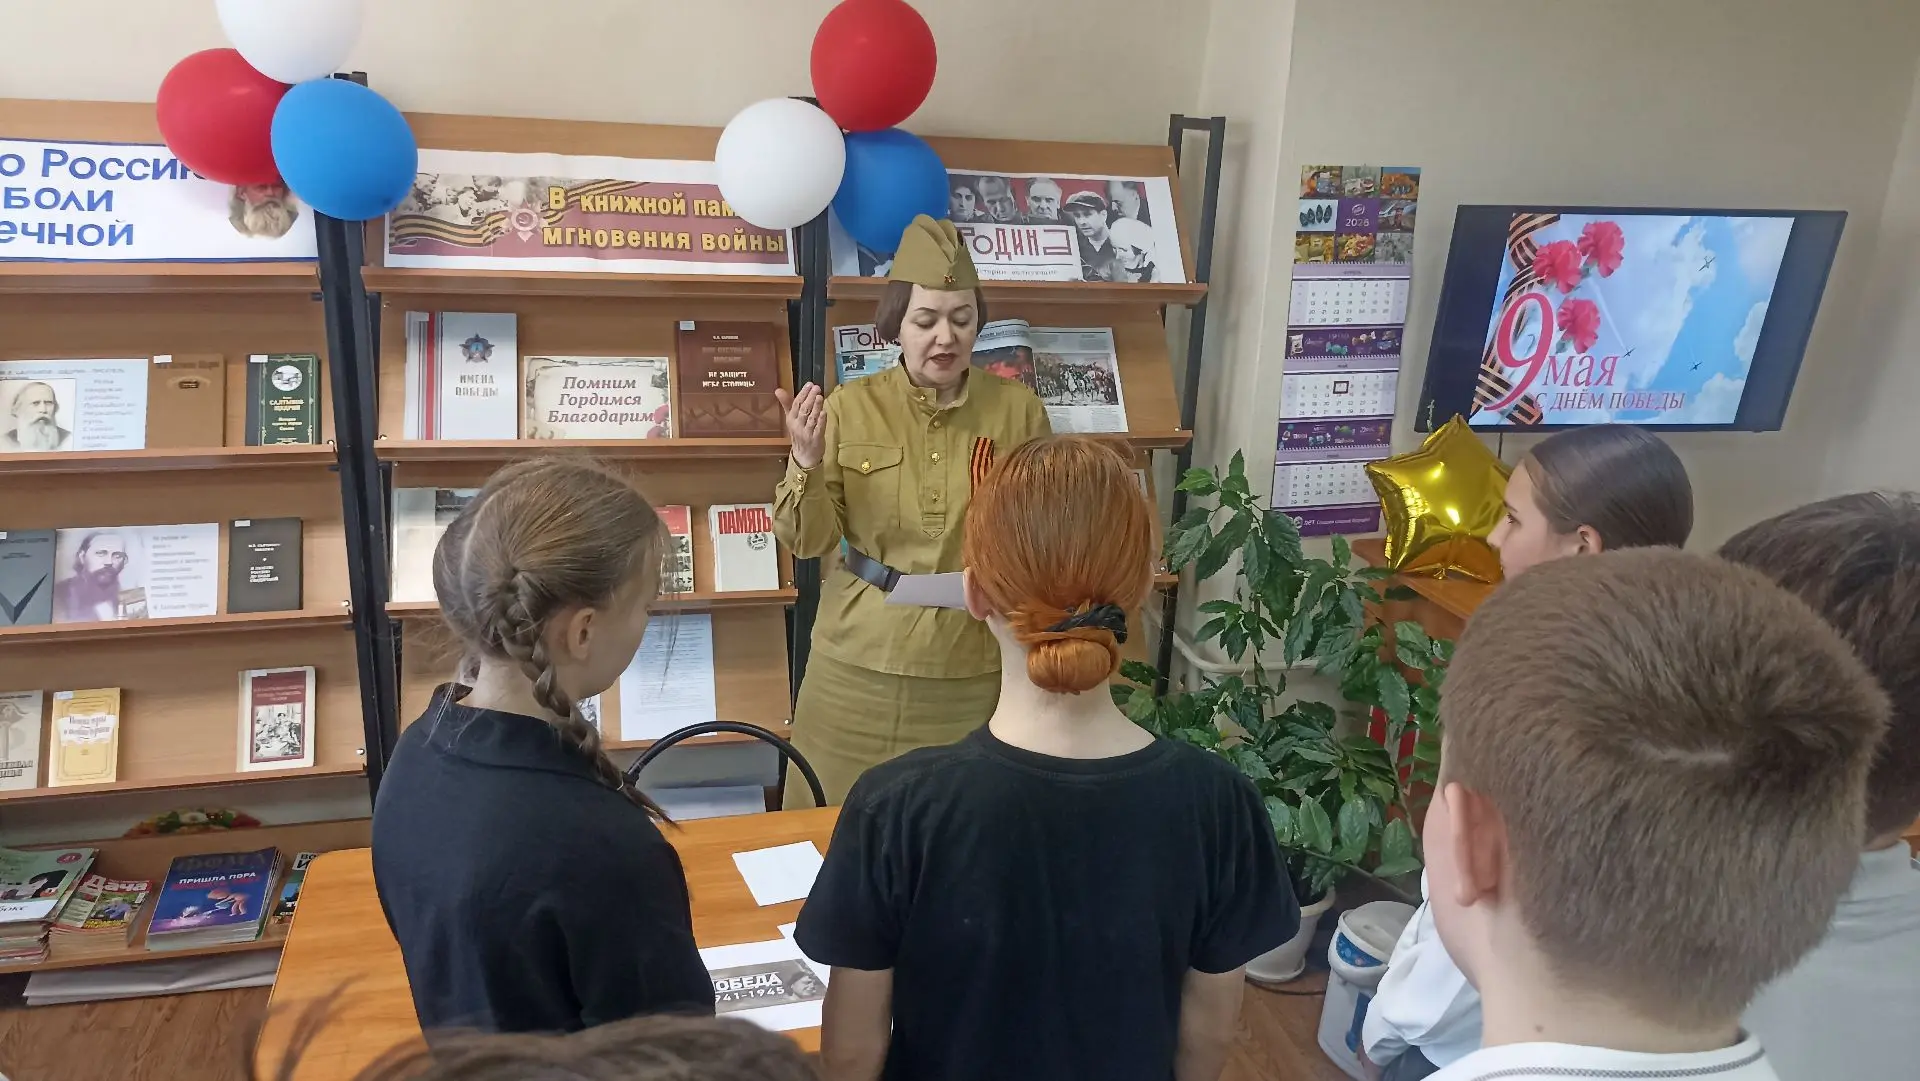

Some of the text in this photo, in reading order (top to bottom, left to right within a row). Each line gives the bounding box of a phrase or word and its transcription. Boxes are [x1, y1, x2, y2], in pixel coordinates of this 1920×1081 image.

[549, 186, 566, 210] В
[580, 191, 687, 217] книжной
[543, 226, 785, 253] мгновения войны
[1484, 292, 1620, 411] 9 мая
[460, 374, 494, 384] ИМЕНА
[562, 376, 637, 390] Помним
[456, 386, 498, 397] ПОБЕДЫ
[558, 392, 642, 408] Гордимся
[1533, 388, 1686, 412] С ДНЁМ ПОБЕДЫ
[547, 410, 654, 426] Благодарим
[718, 508, 772, 534] ПАМЯТЬ
[78, 874, 149, 896] Дача
[179, 872, 256, 884] ПРИШЛА ПОРА
